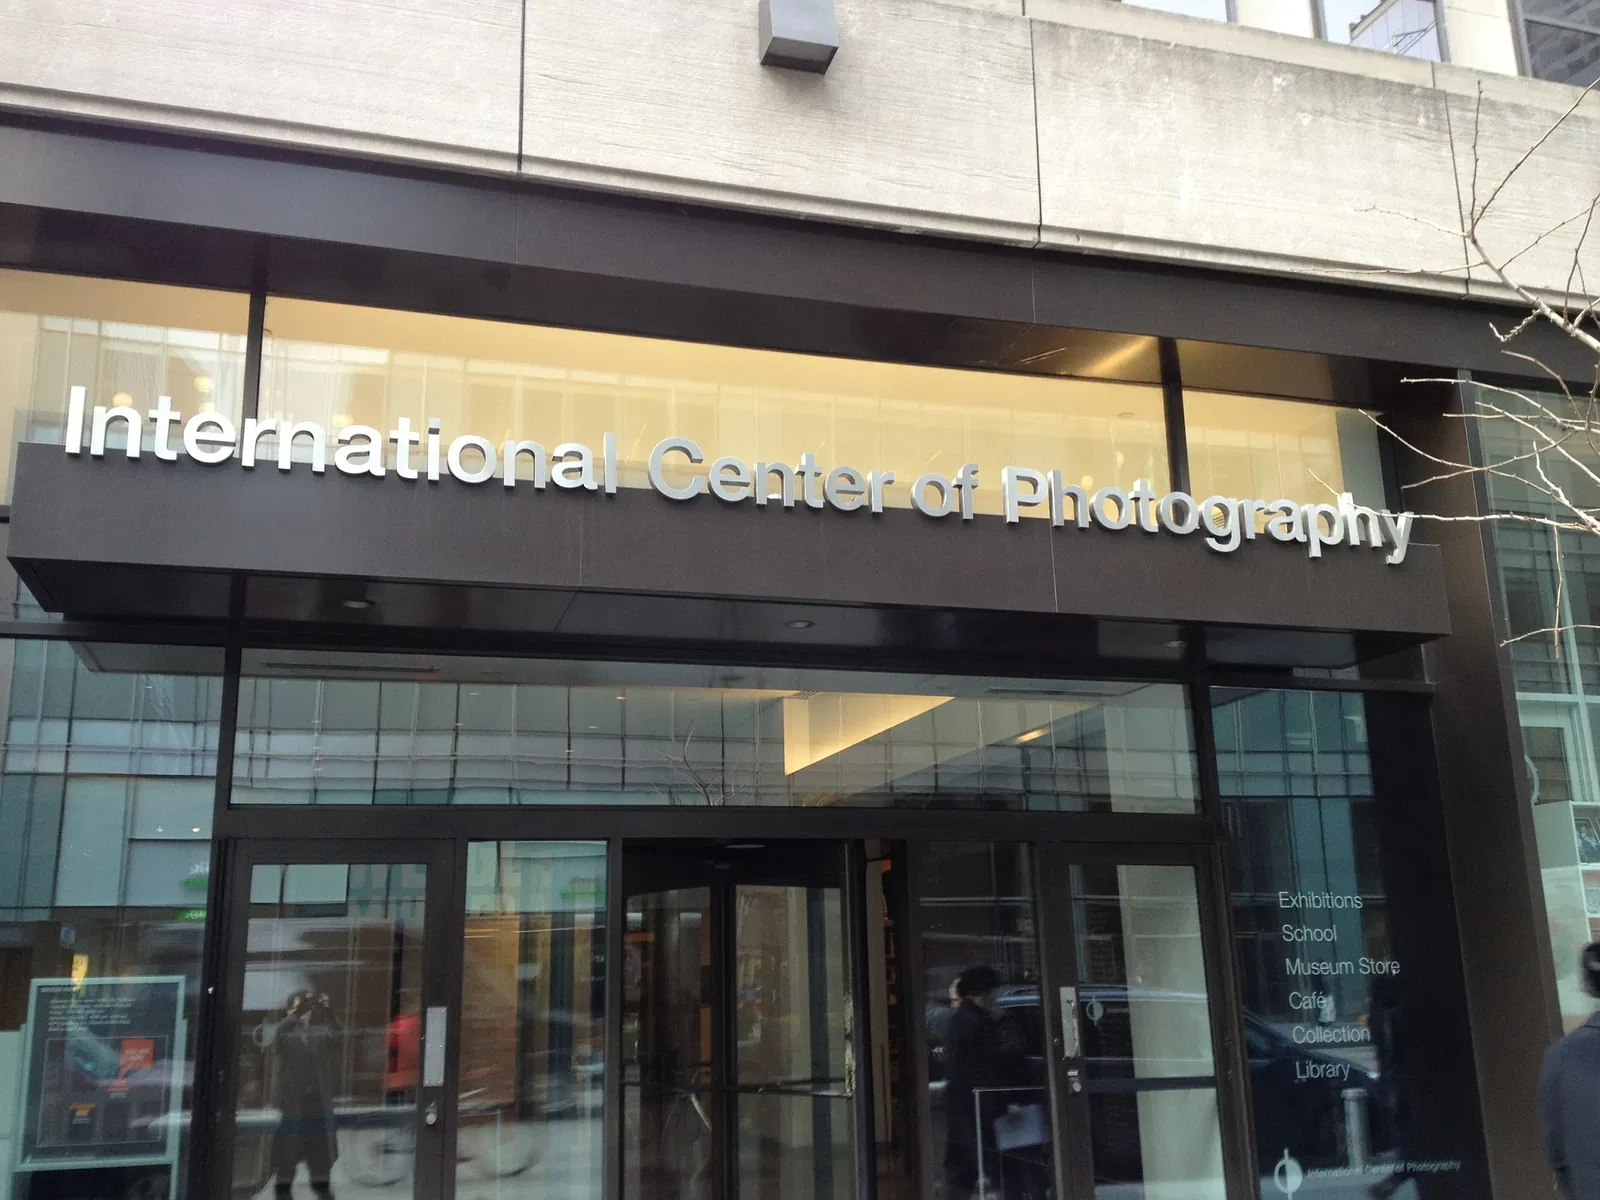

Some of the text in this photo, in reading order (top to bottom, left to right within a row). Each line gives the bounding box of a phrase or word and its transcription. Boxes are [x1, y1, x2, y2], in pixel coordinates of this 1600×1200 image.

[64, 385, 1414, 565] International Center of Photography
[1278, 891, 1363, 910] Exhibitions
[1282, 924, 1338, 942] School
[1285, 957, 1401, 976] Museum Store
[1289, 991, 1326, 1010] Café
[1292, 1026, 1371, 1045] Collection
[1295, 1061, 1350, 1082] Library
[1306, 1159, 1461, 1179] International Center of Photography
